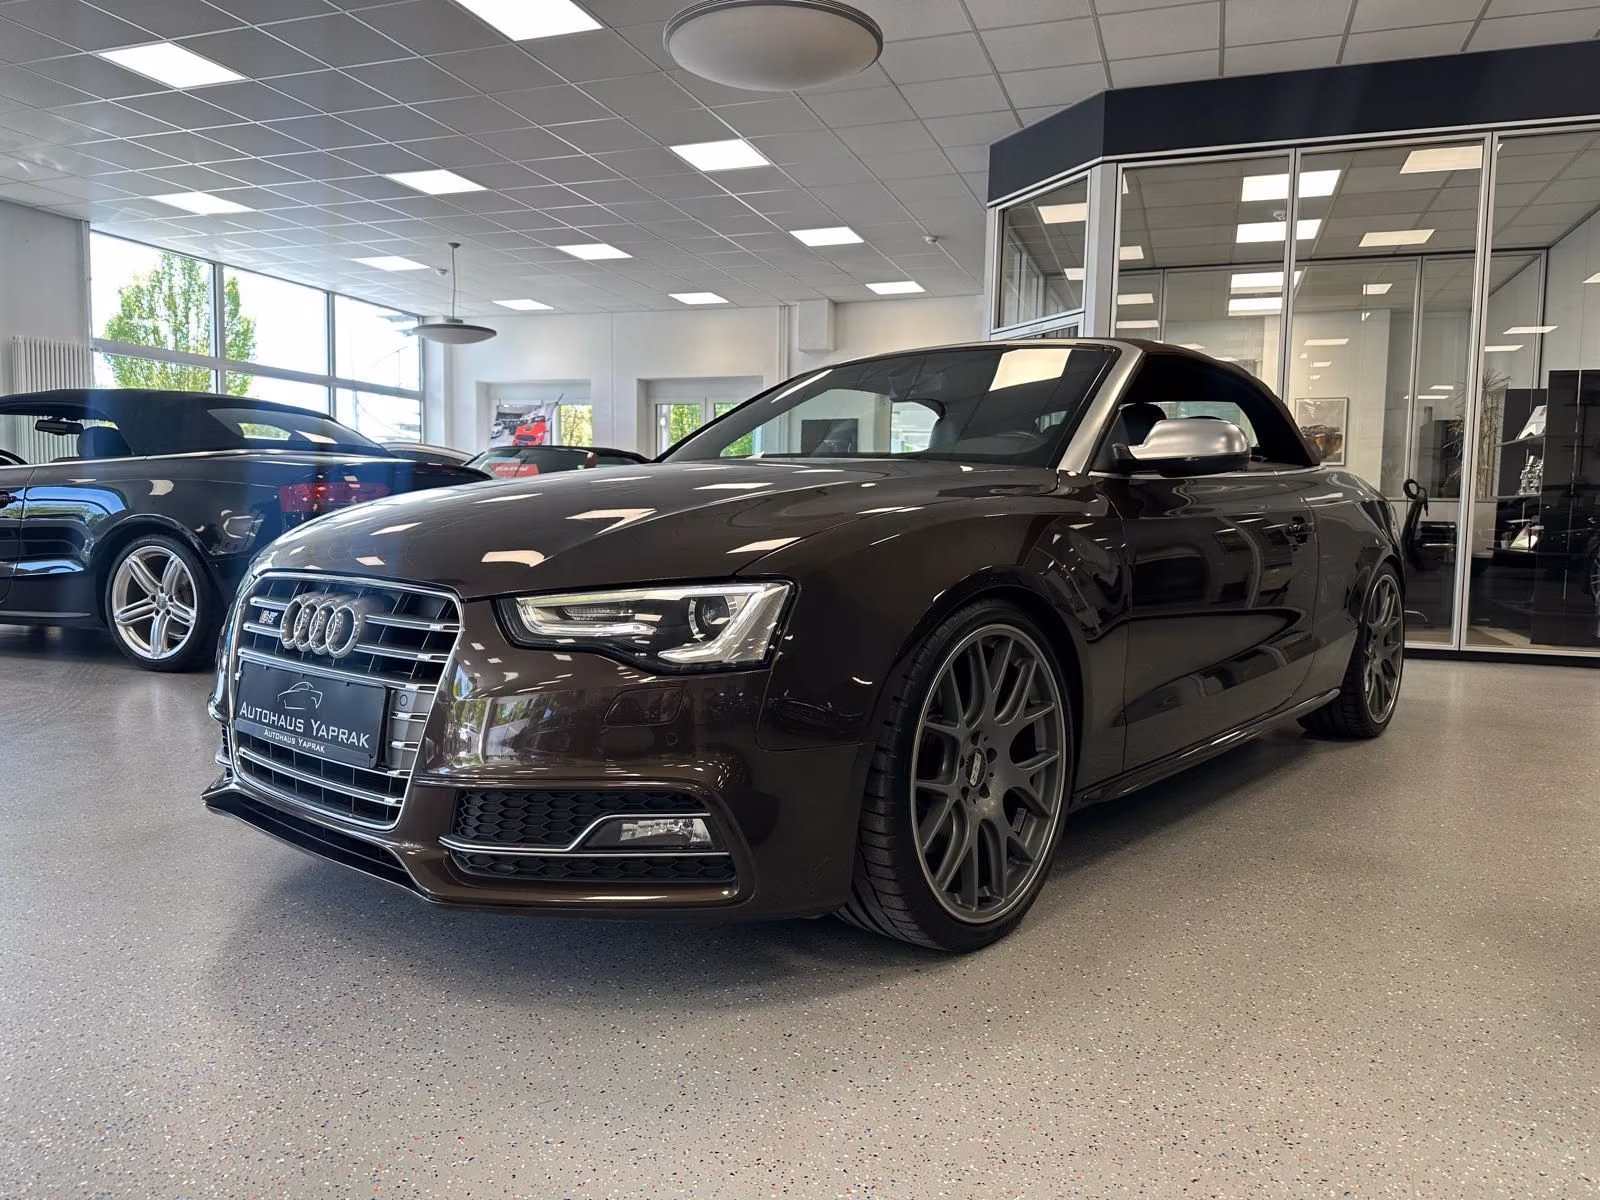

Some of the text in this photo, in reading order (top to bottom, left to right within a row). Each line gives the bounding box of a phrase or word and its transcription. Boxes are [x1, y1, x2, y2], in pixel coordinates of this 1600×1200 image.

[239, 702, 370, 749] AUTOHAUS YAPRAK
[264, 729, 325, 754] AUTOHAUS YAPRAK
